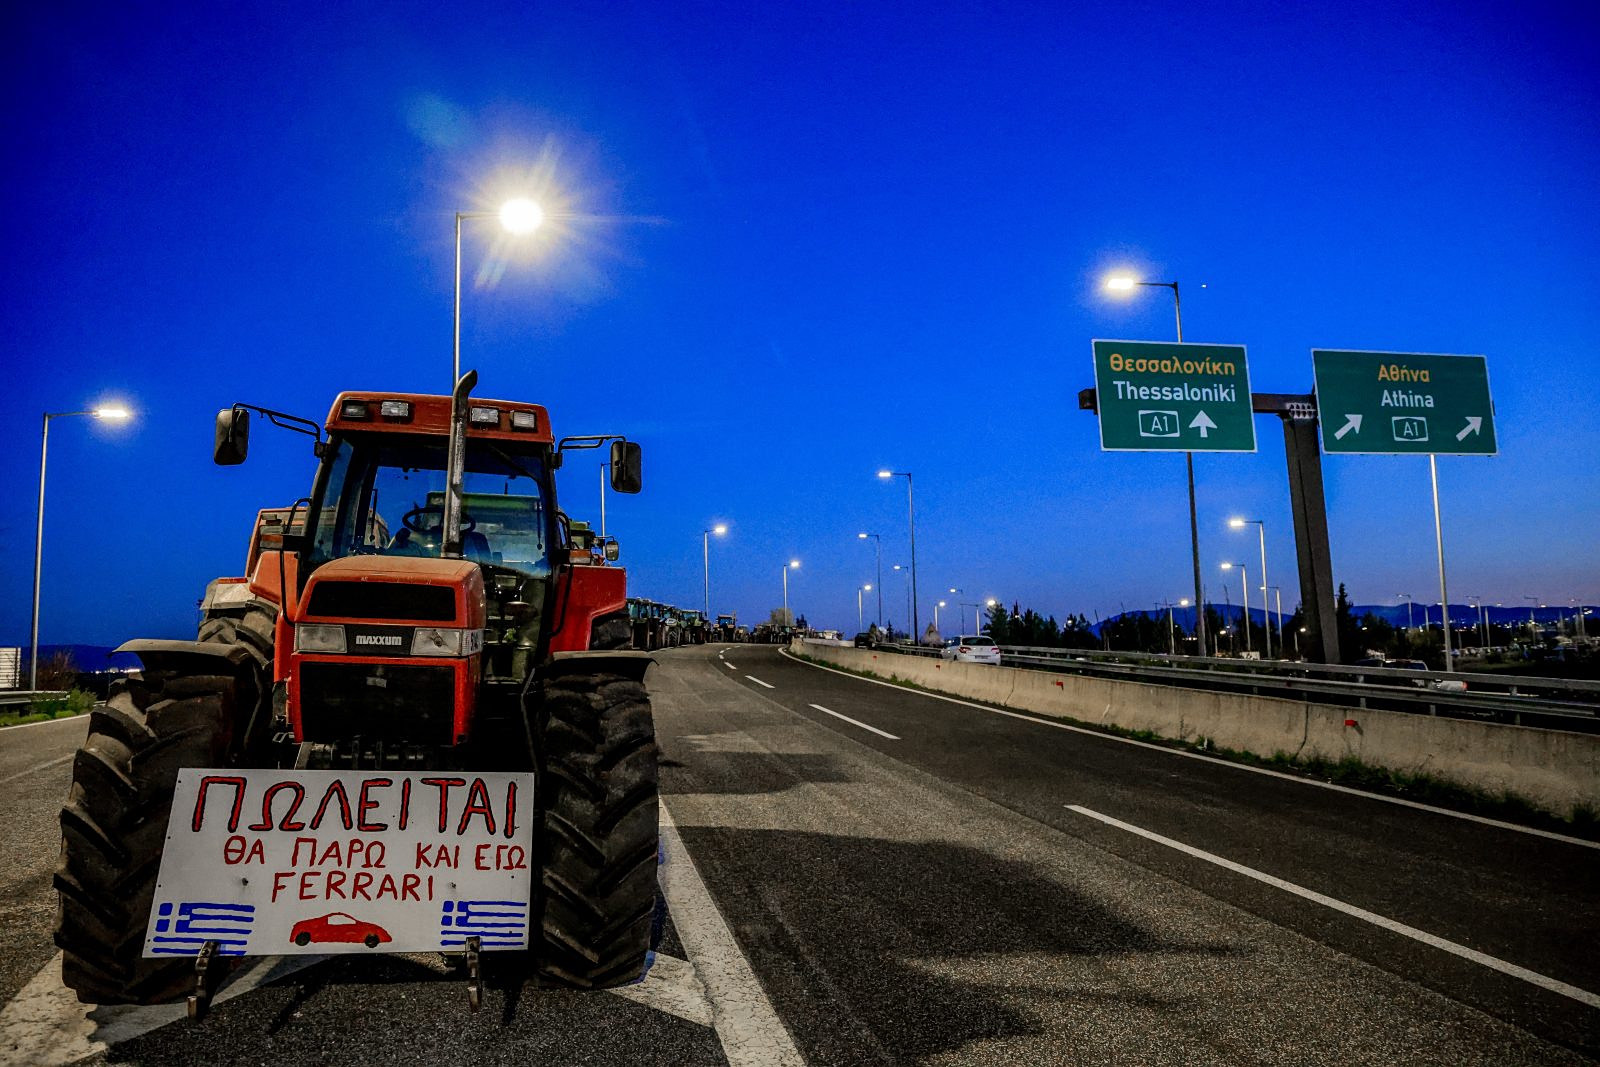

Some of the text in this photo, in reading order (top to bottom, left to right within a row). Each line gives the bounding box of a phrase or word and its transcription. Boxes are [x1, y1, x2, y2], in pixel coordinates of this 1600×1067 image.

[1109, 353, 1236, 377] Θεσσαλονίκη
[1378, 364, 1431, 383] Αθήνα
[1113, 381, 1236, 402] Thessaloniki
[1381, 389, 1434, 408] Athina
[1151, 416, 1170, 433] A1
[1403, 421, 1419, 437] A1
[192, 776, 516, 838] ΠΩΛΕΙΤΑΙ
[223, 835, 527, 871] ΘΑ ΠΑΡΩ ΚΑΙ ΕΓΩ
[271, 871, 434, 902] FERRARI
